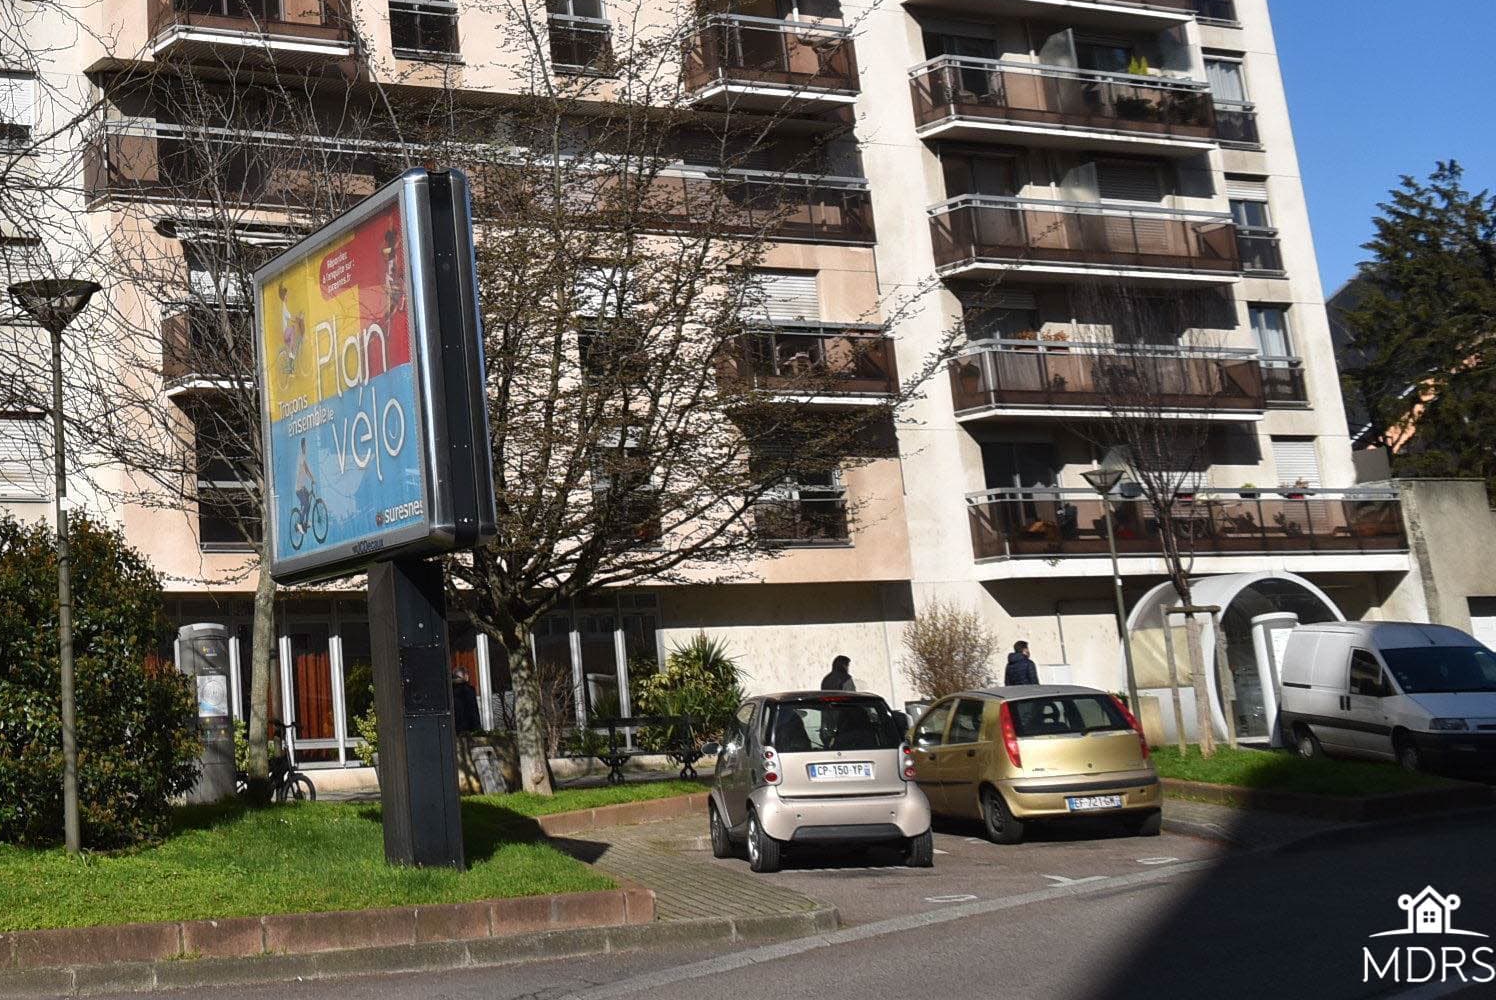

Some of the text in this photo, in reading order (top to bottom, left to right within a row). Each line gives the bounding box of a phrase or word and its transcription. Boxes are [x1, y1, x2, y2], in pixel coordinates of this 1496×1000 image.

[315, 314, 387, 401] Plan
[278, 394, 308, 420] Traçons
[288, 407, 327, 437] ensemble
[331, 386, 405, 481] vélo
